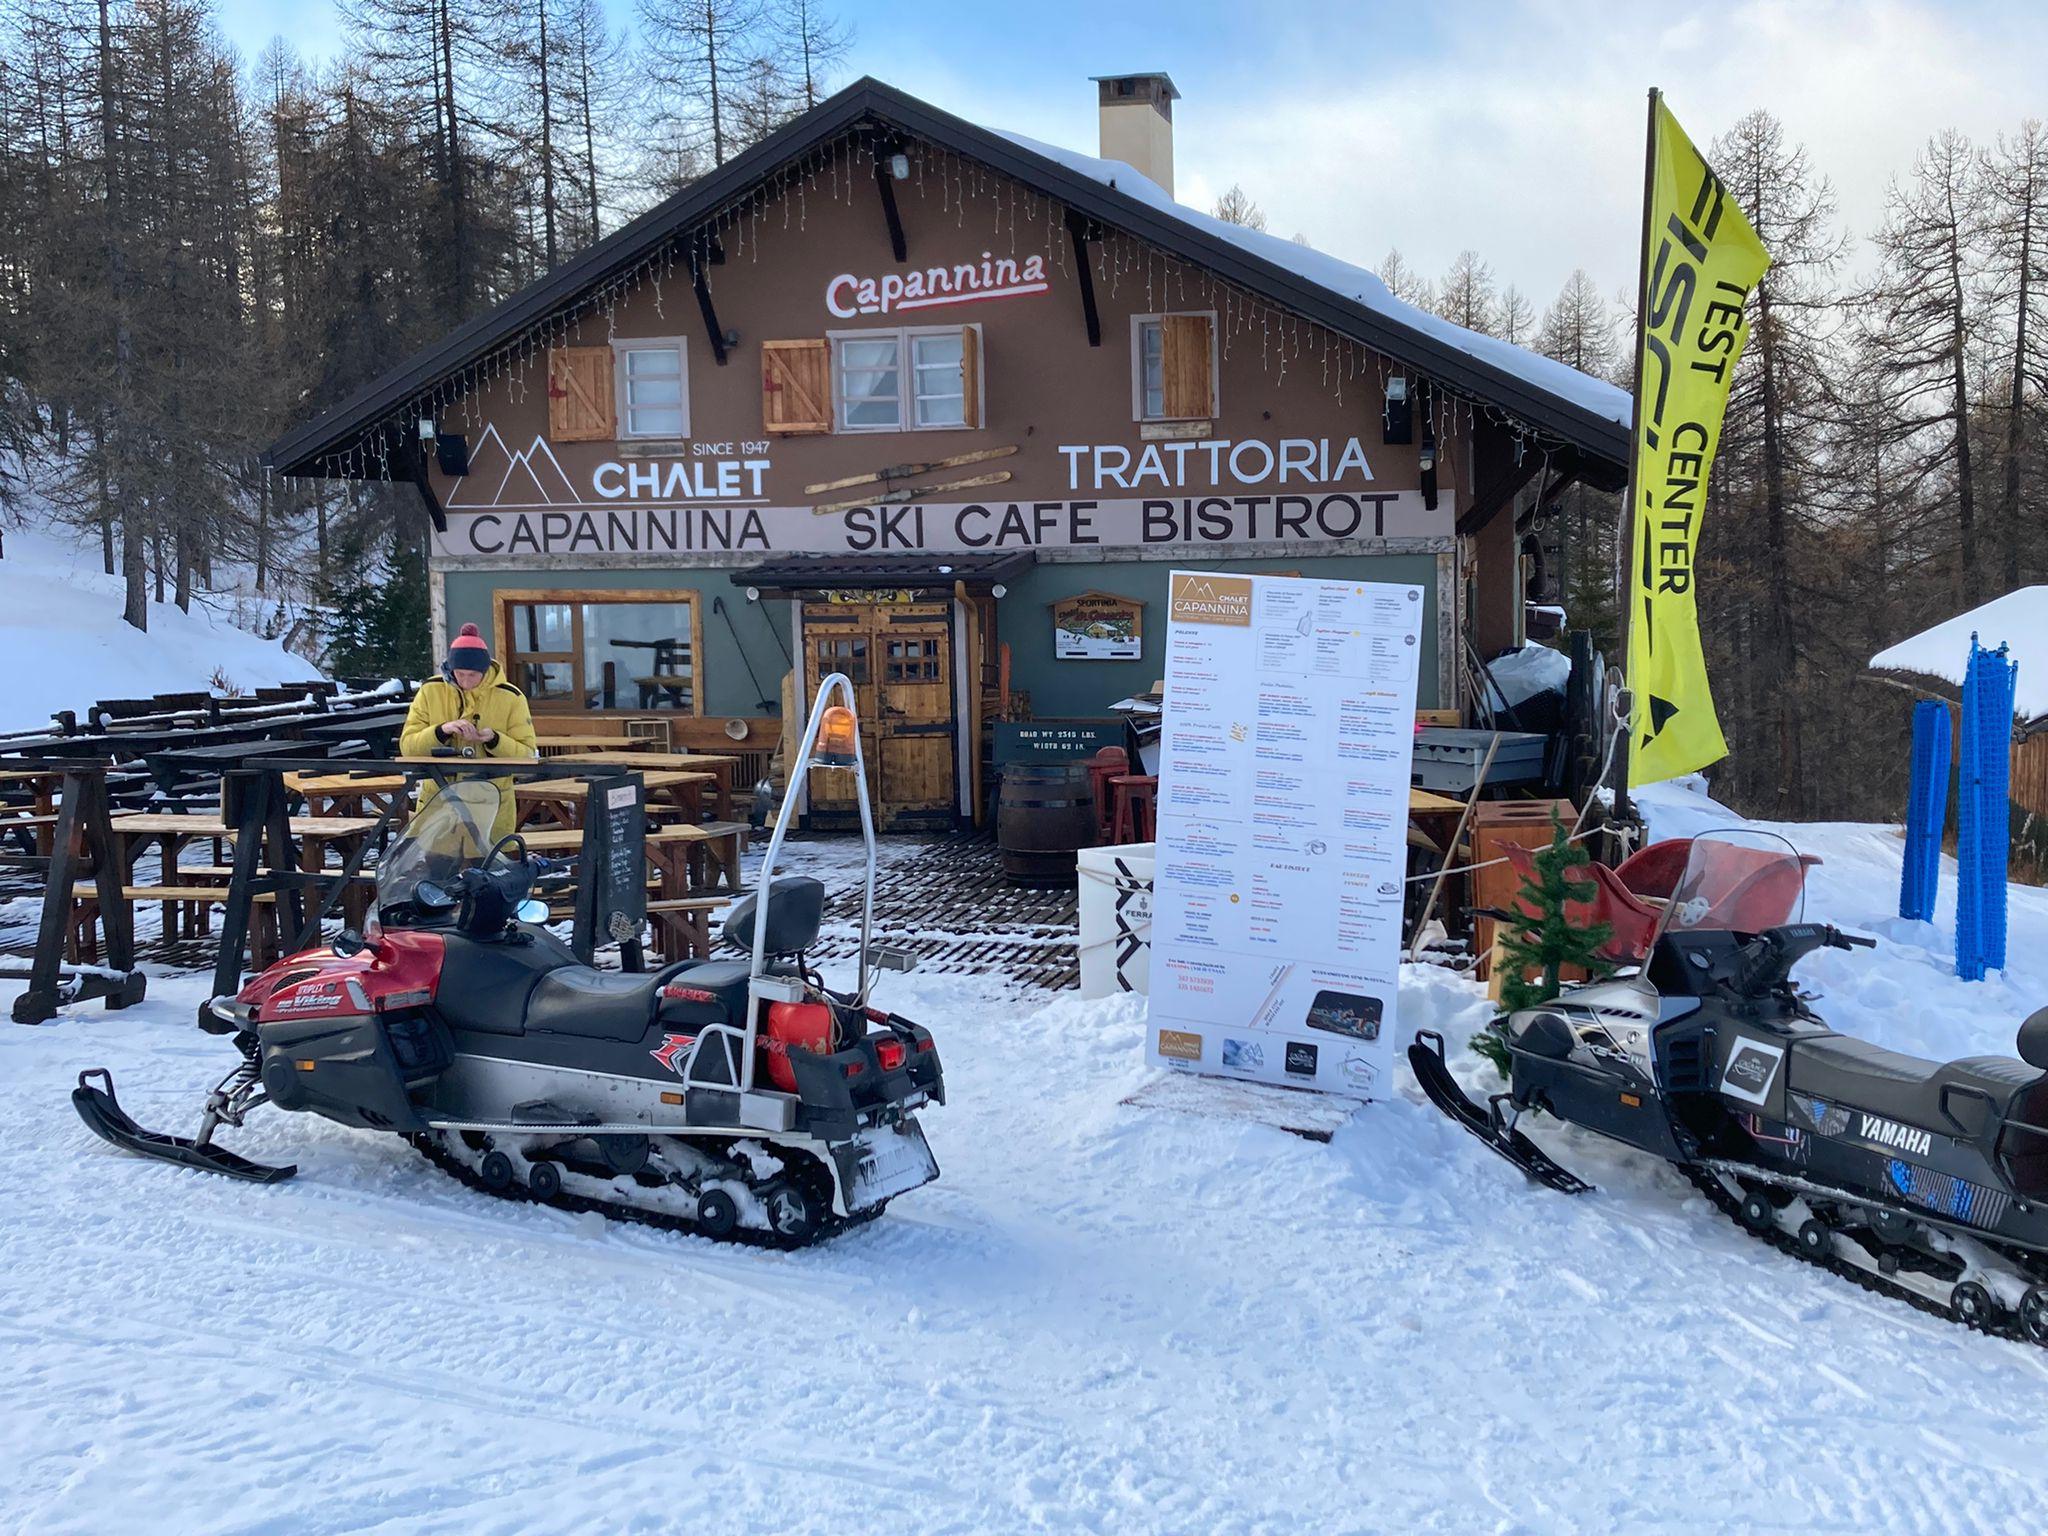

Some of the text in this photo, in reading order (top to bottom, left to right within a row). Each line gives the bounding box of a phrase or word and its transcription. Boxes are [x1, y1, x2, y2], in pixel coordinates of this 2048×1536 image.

[826, 252, 1049, 318] Capannina
[692, 440, 770, 456] SINCE 1947
[1658, 279, 1751, 596] TEST CENTER
[593, 460, 770, 498] CHALET
[1058, 437, 1375, 489] TRATTORIA
[468, 494, 1400, 554] CAPANNINA SKI CAFE BISTROT
[1173, 601, 1248, 616] CAPANNINA
[1219, 594, 1248, 603] CHALET
[1859, 1115, 1932, 1157] YAMAHA
